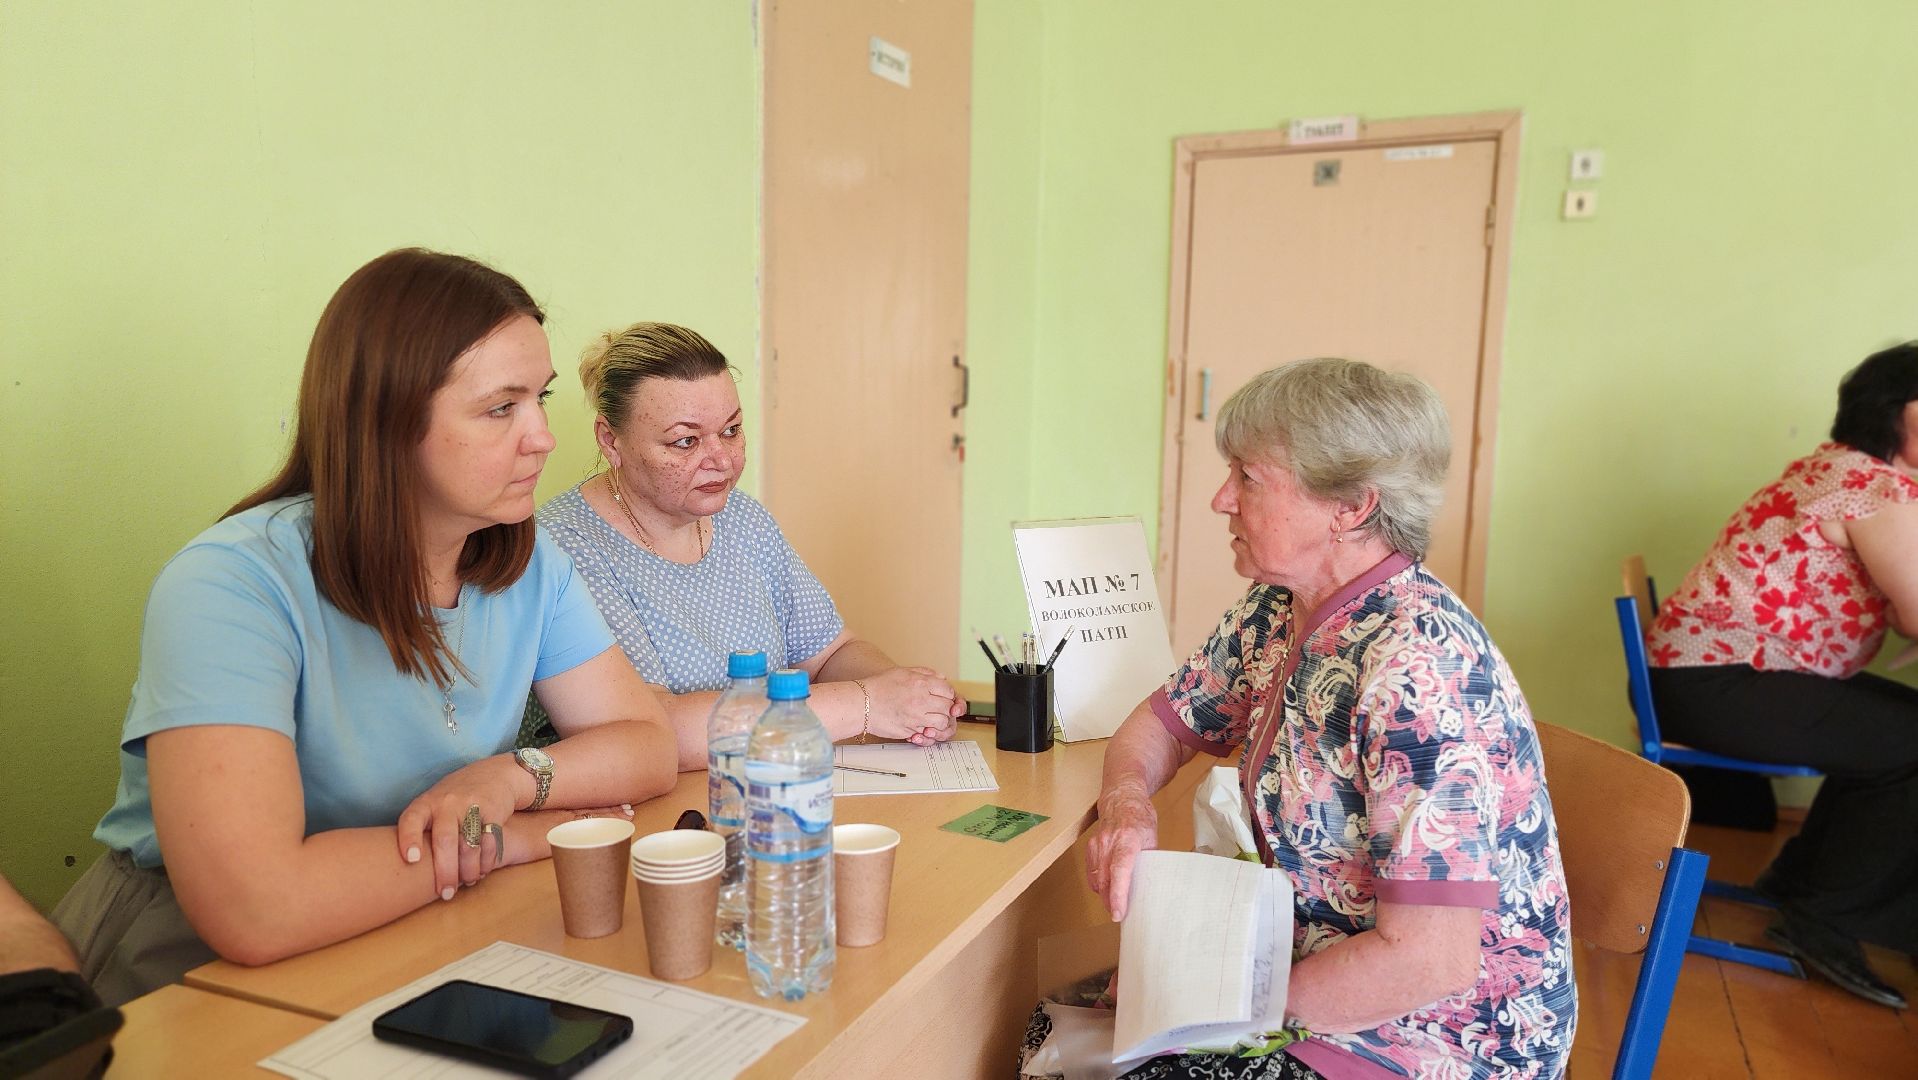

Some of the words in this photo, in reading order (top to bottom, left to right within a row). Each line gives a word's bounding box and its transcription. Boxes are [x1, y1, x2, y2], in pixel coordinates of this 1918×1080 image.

[1043, 576, 1099, 598] МАП
[1104, 574, 1126, 593] №
[1130, 573, 1140, 591] 7
[1041, 601, 1156, 622] ВОЛОКОЛАМСКОЕ
[1080, 625, 1129, 643] ПАТП
